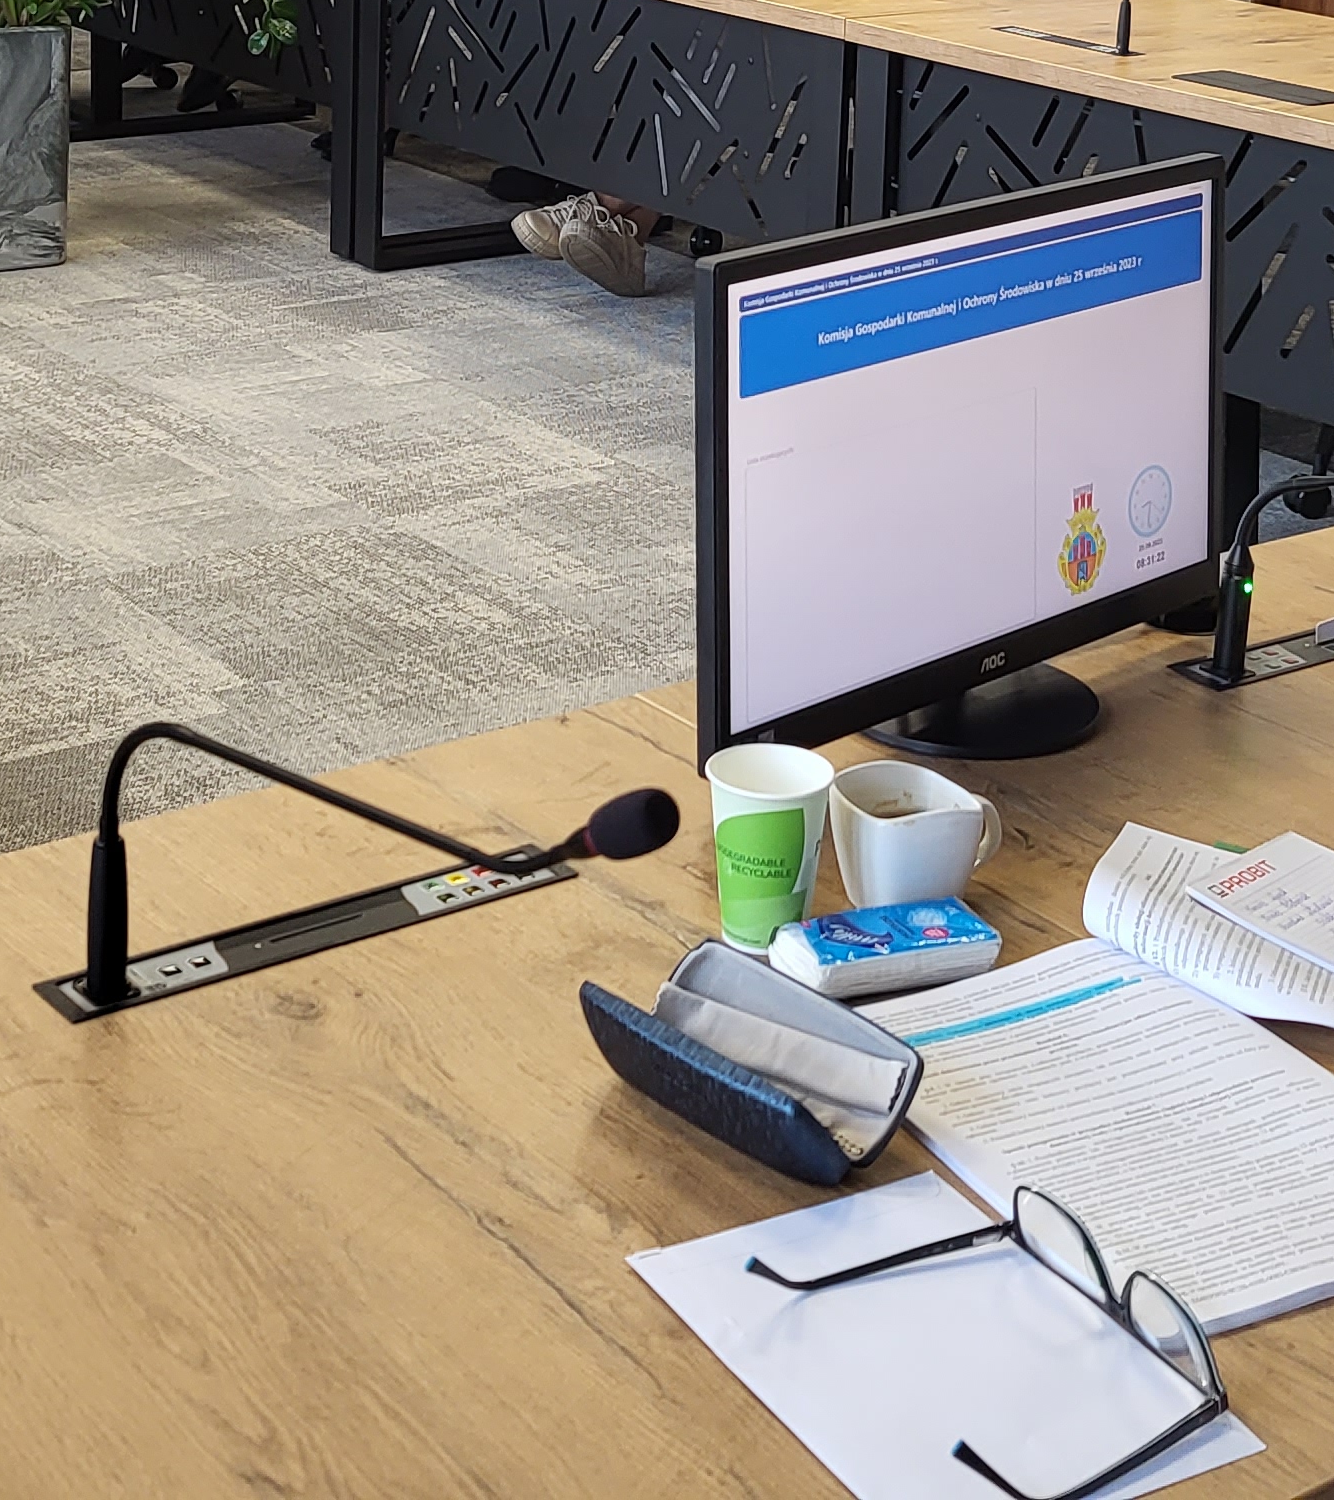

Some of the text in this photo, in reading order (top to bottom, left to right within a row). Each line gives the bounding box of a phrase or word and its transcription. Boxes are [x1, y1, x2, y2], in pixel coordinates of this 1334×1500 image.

[818, 325, 854, 346] Komisja
[855, 312, 905, 336] Gospodarki
[906, 300, 957, 324] Komunalnej
[962, 291, 998, 310] Ochrony
[999, 280, 1045, 301] Środowiska
[1045, 279, 1053, 289] w
[1054, 273, 1072, 287] dniu
[1073, 269, 1083, 283] 25
[1084, 263, 1118, 279] września
[1118, 257, 1137, 272] 2023
[980, 651, 1006, 674] AOC
[731, 862, 792, 879] RECYCLABLE
[1219, 859, 1277, 893] PROBIT
